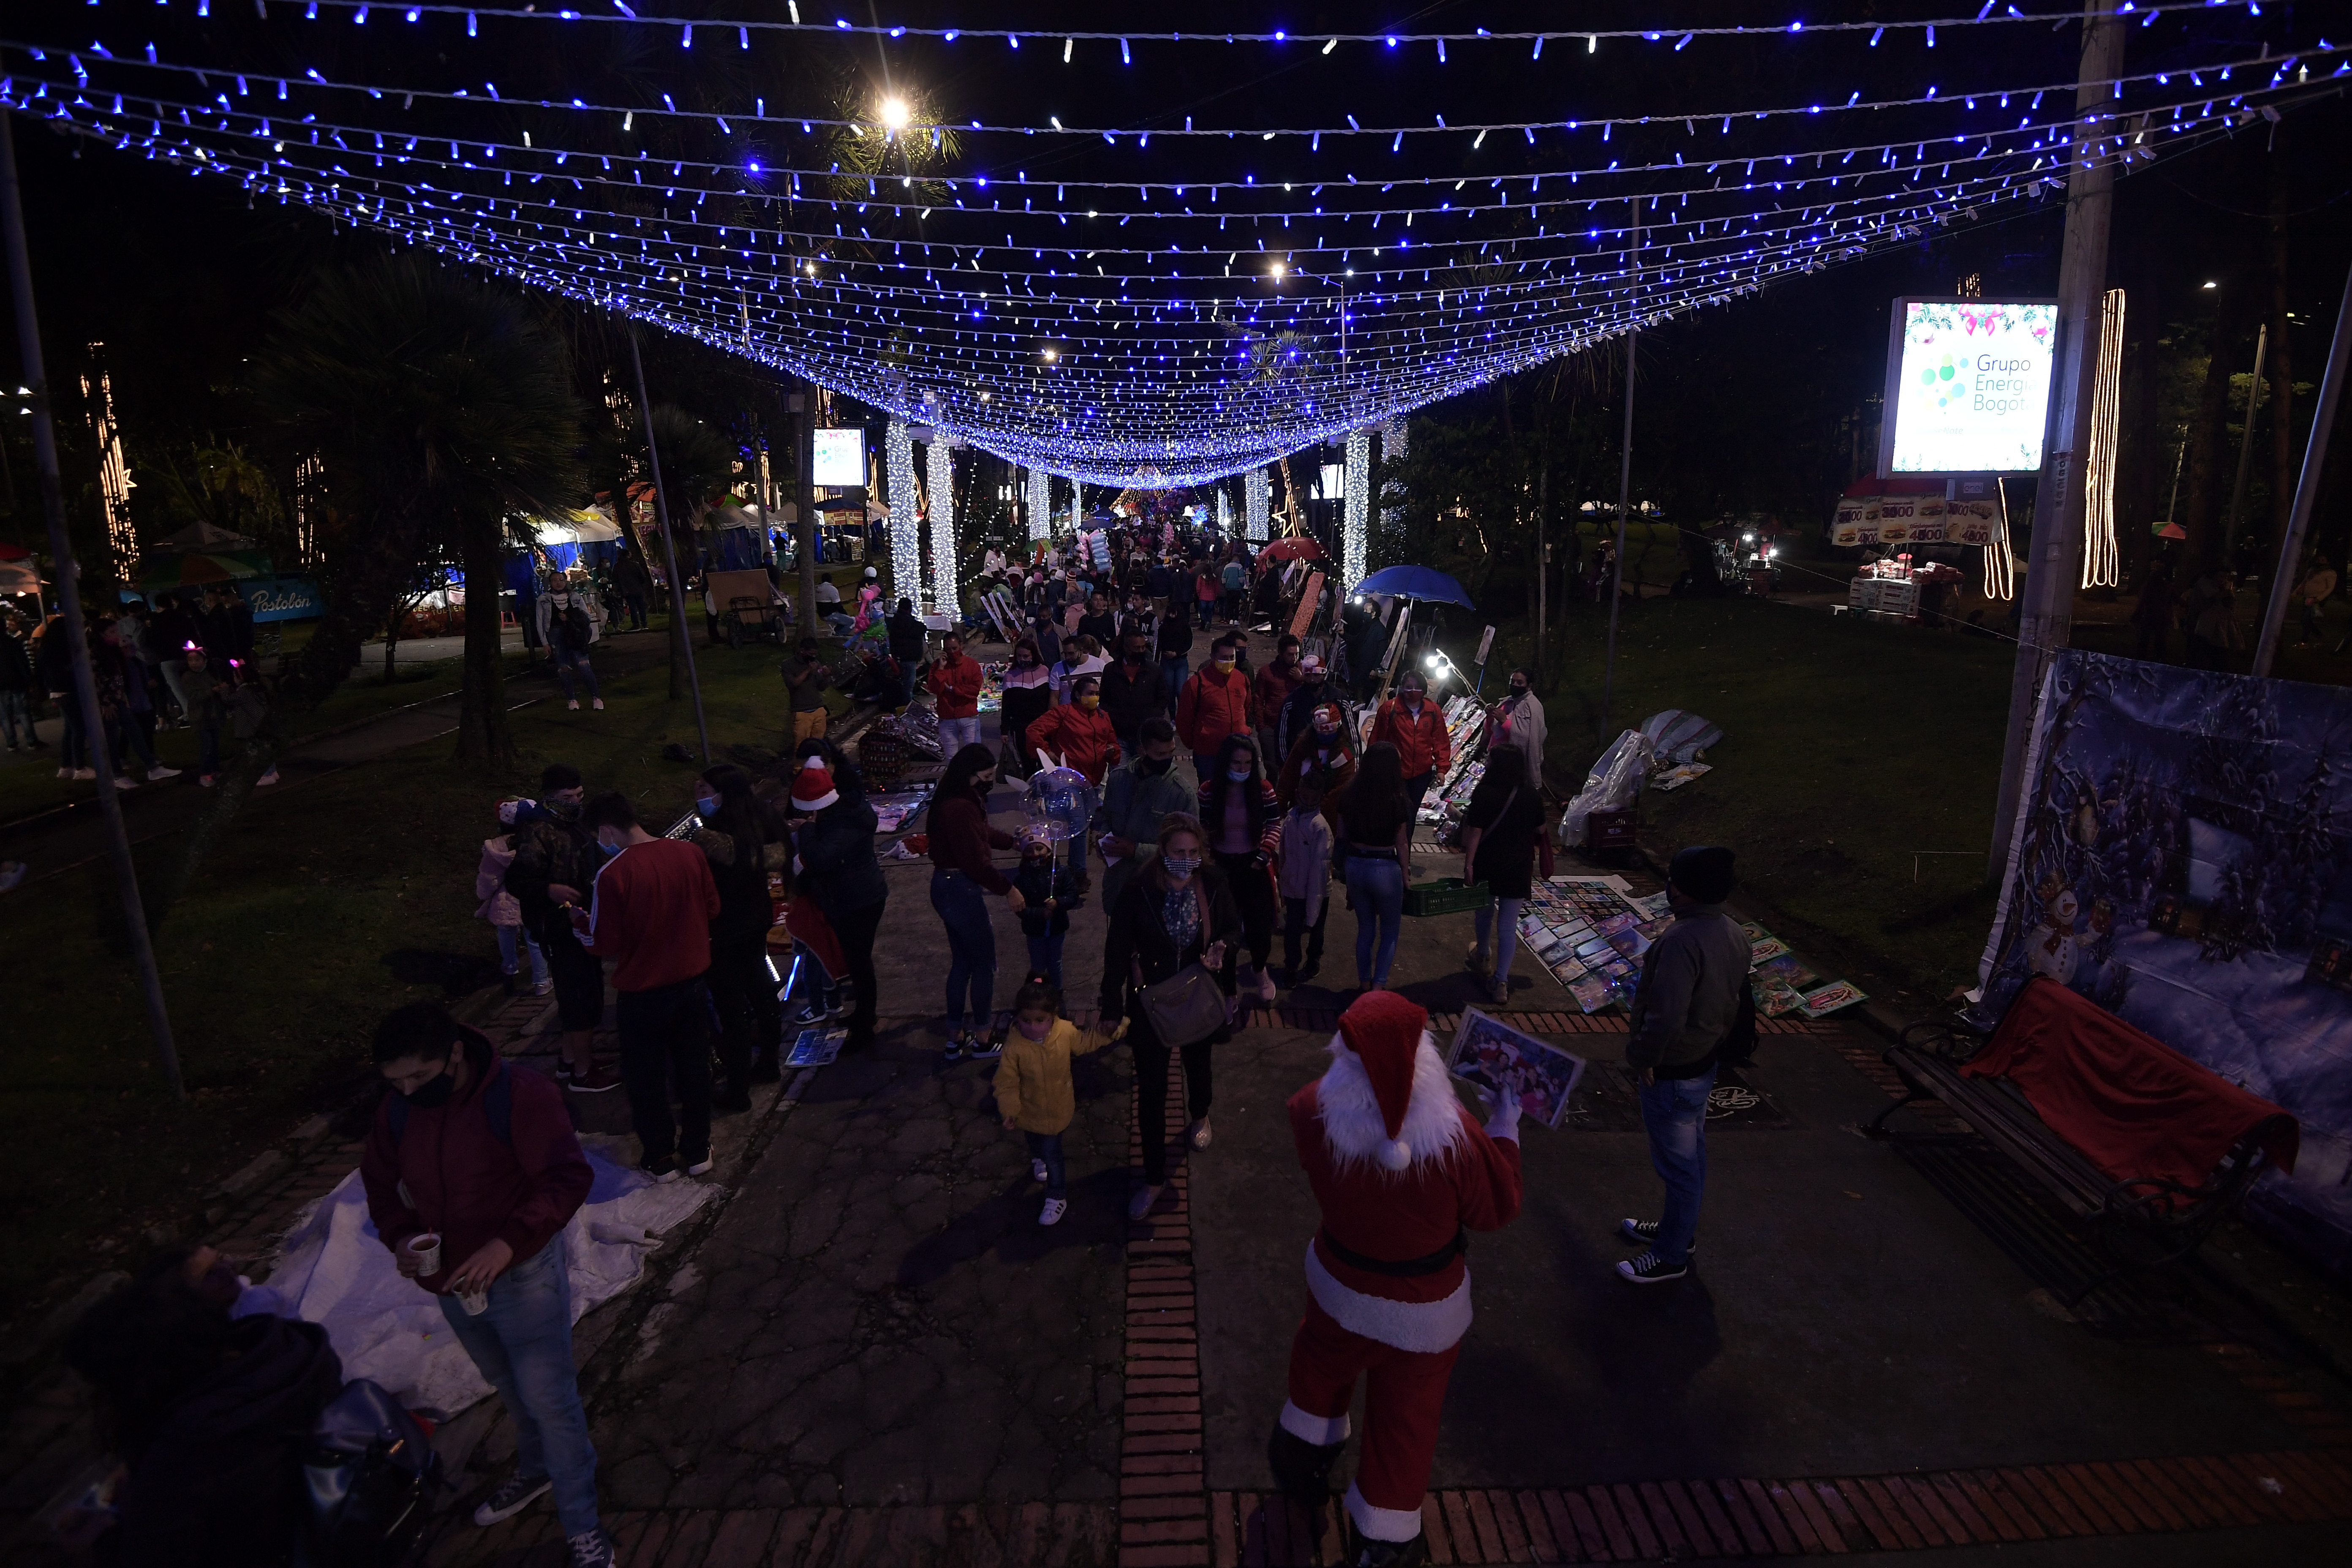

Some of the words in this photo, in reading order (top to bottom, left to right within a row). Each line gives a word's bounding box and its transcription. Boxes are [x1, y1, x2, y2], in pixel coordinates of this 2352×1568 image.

[1977, 354, 2031, 376] Grupo
[1976, 374, 2037, 395] Energía
[251, 590, 311, 612] Postobón
[1141, 623, 1149, 632] N
